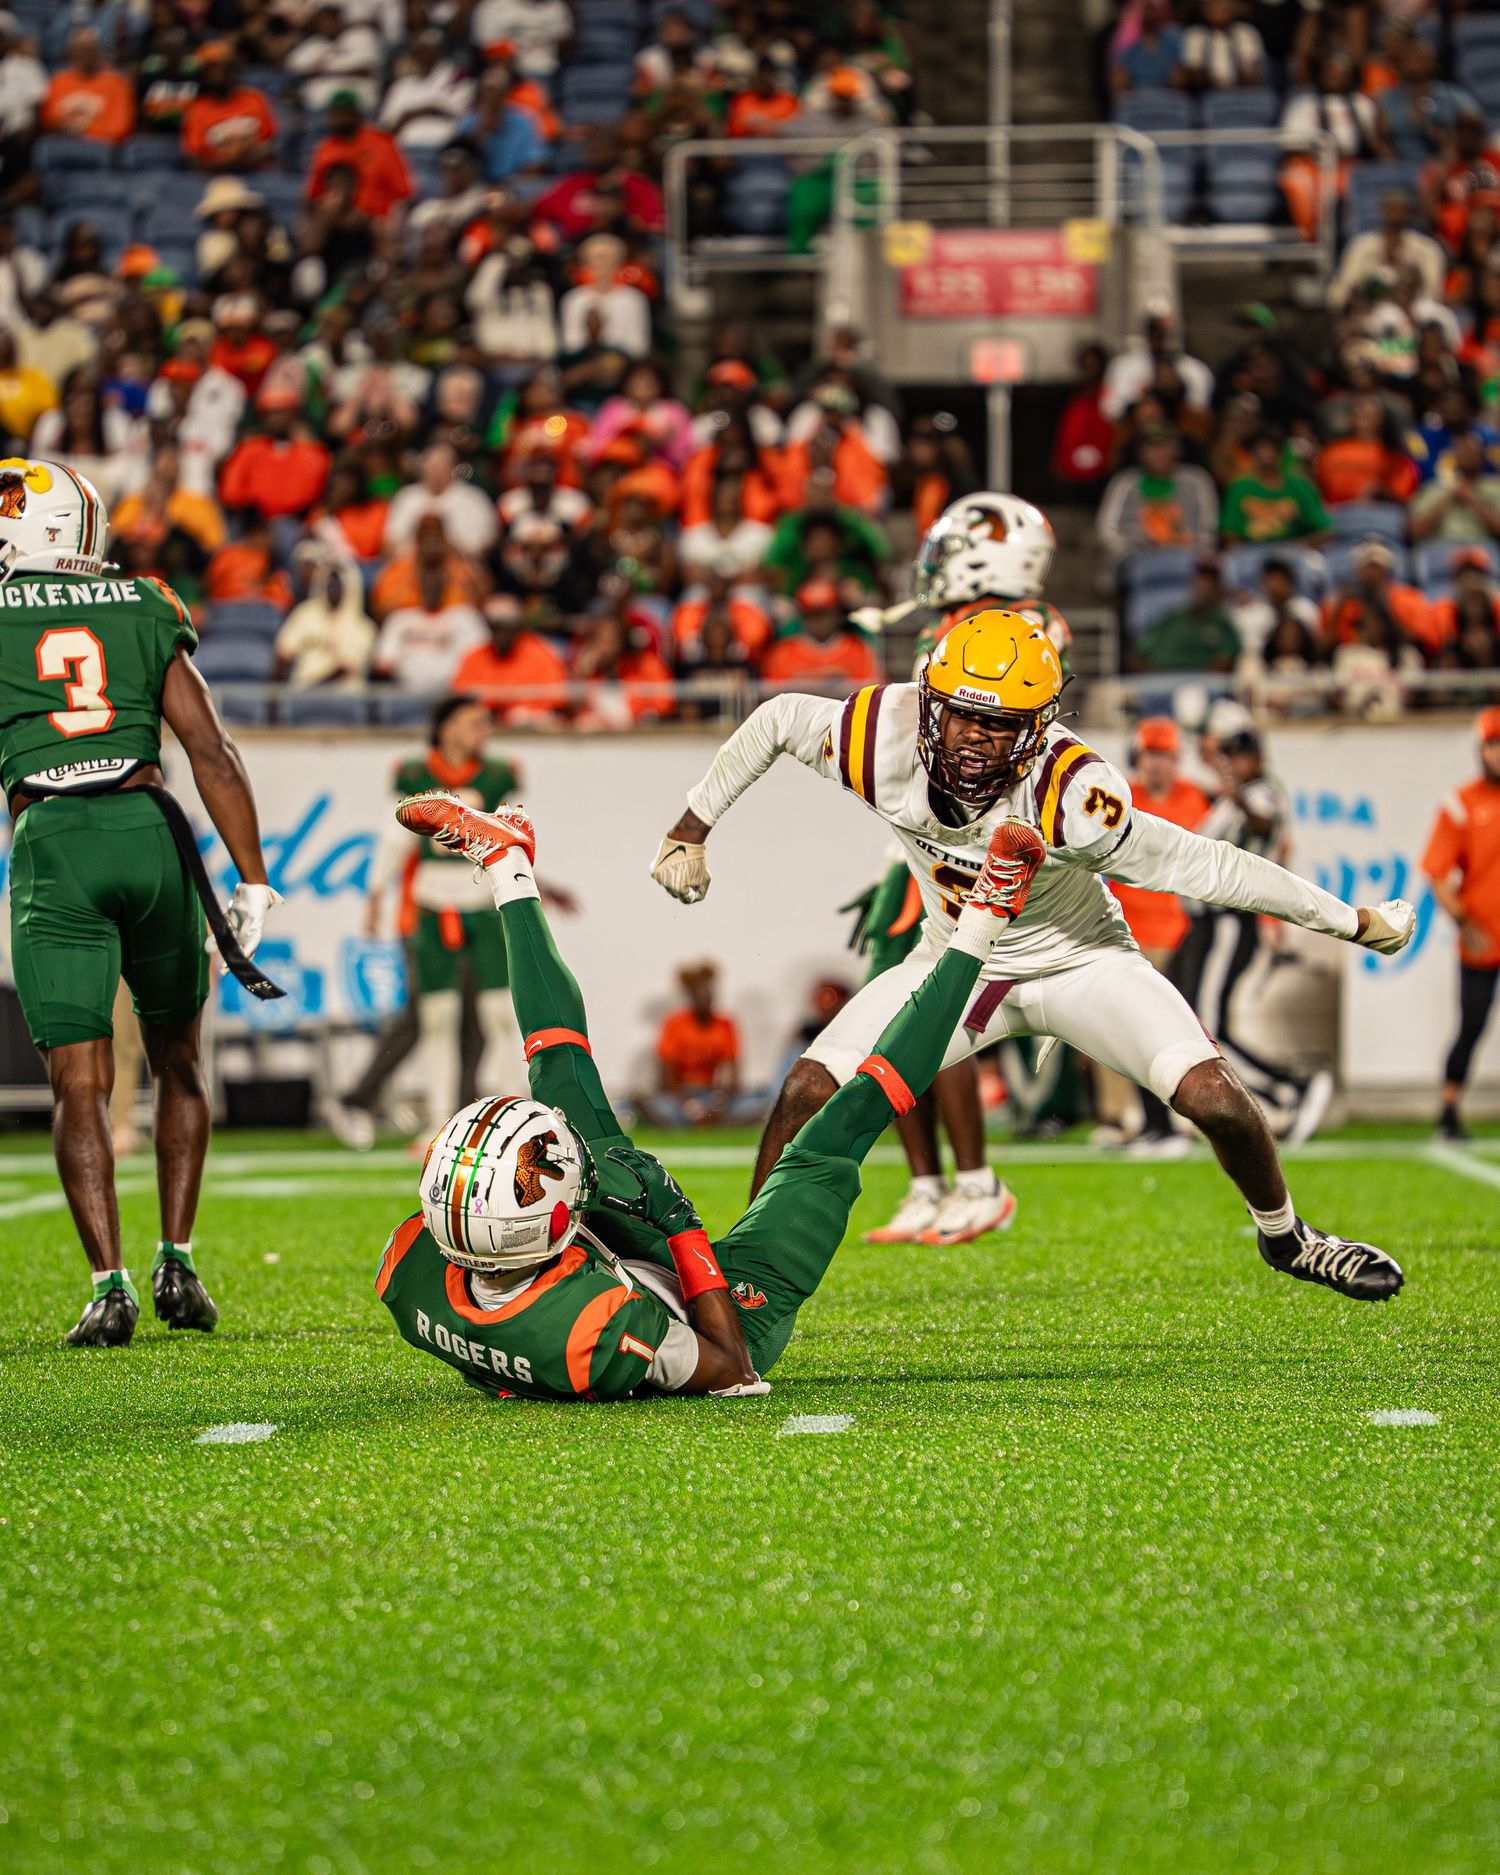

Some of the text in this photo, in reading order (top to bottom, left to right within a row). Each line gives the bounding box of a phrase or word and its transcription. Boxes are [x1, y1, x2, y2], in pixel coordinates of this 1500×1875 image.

[35, 626, 116, 738] 3
[958, 687, 996, 704] Riddell
[55, 757, 119, 778] BATTLE
[1083, 785, 1126, 831] 3
[415, 1307, 534, 1385] ROGERS
